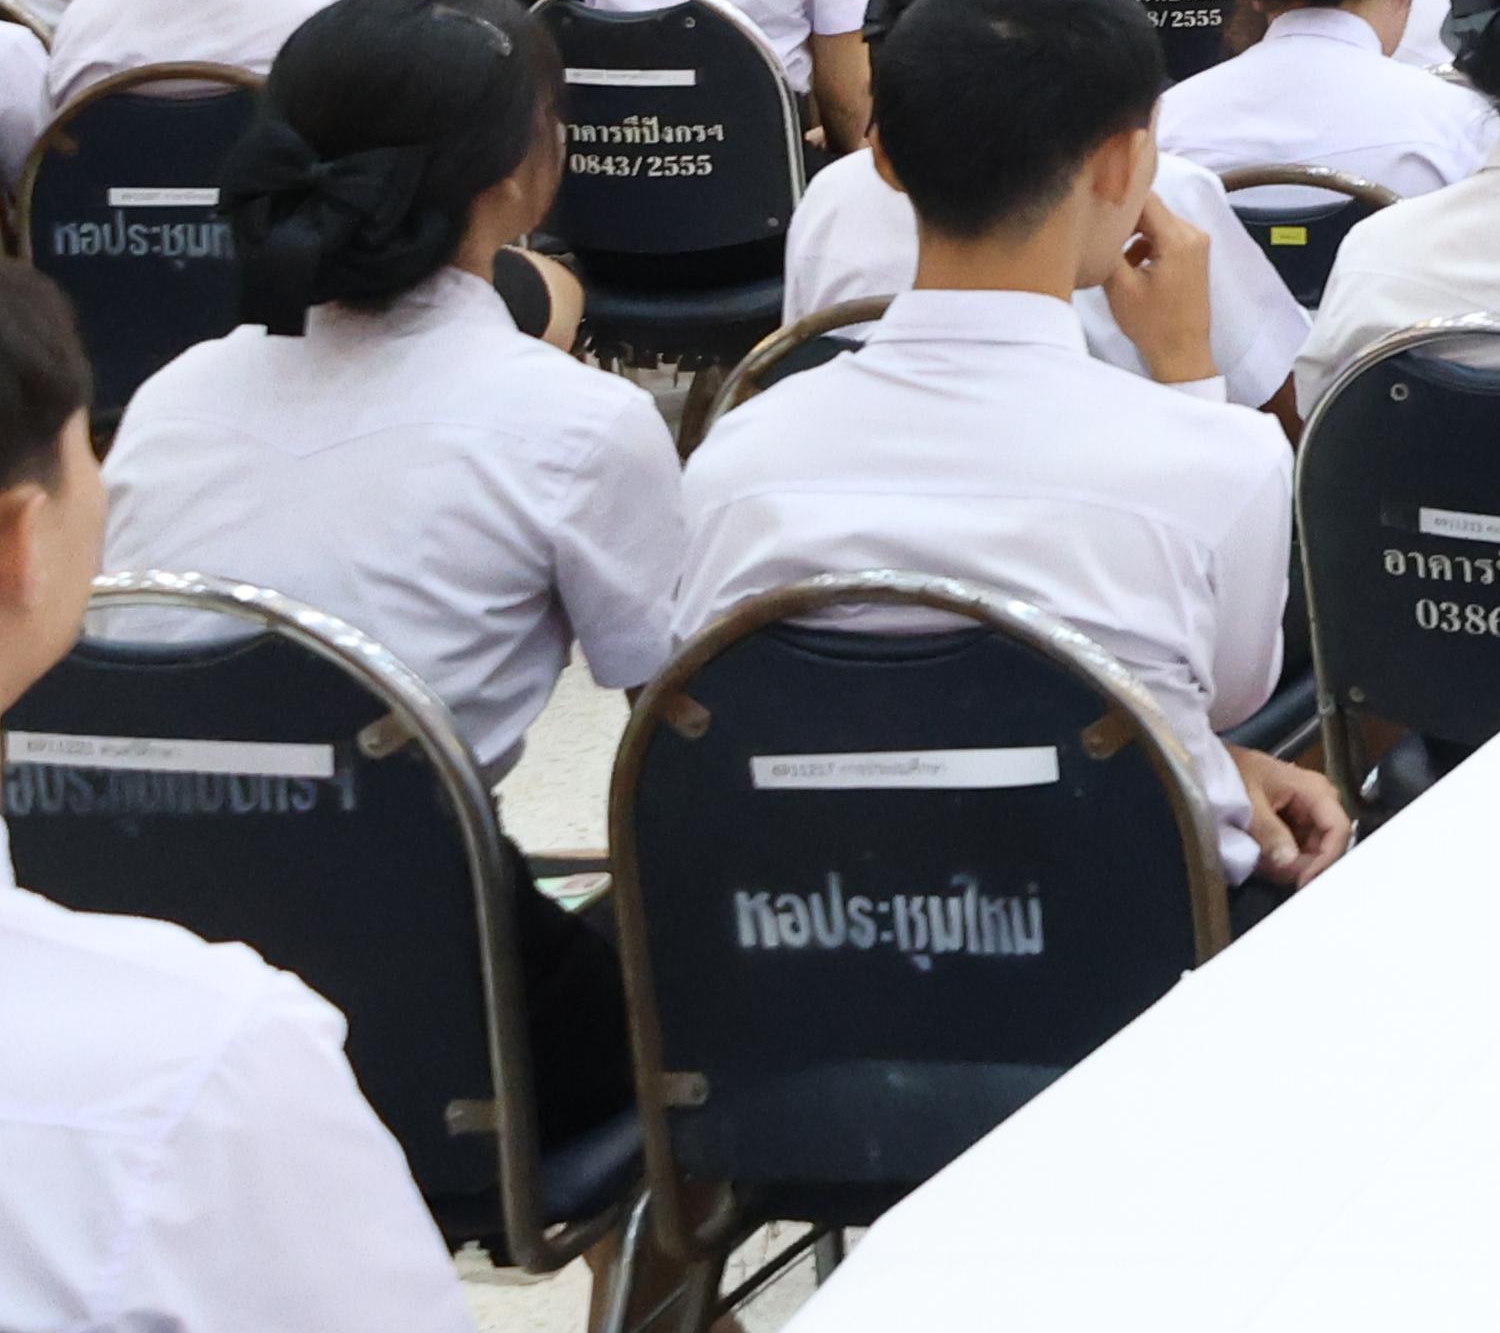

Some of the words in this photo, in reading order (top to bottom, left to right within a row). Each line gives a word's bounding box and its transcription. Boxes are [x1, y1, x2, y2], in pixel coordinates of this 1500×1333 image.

[565, 114, 726, 145] าคารทีปังกรฯ
[569, 152, 714, 178] 0843/2555
[734, 871, 1046, 971] หอประชุมใหม่
